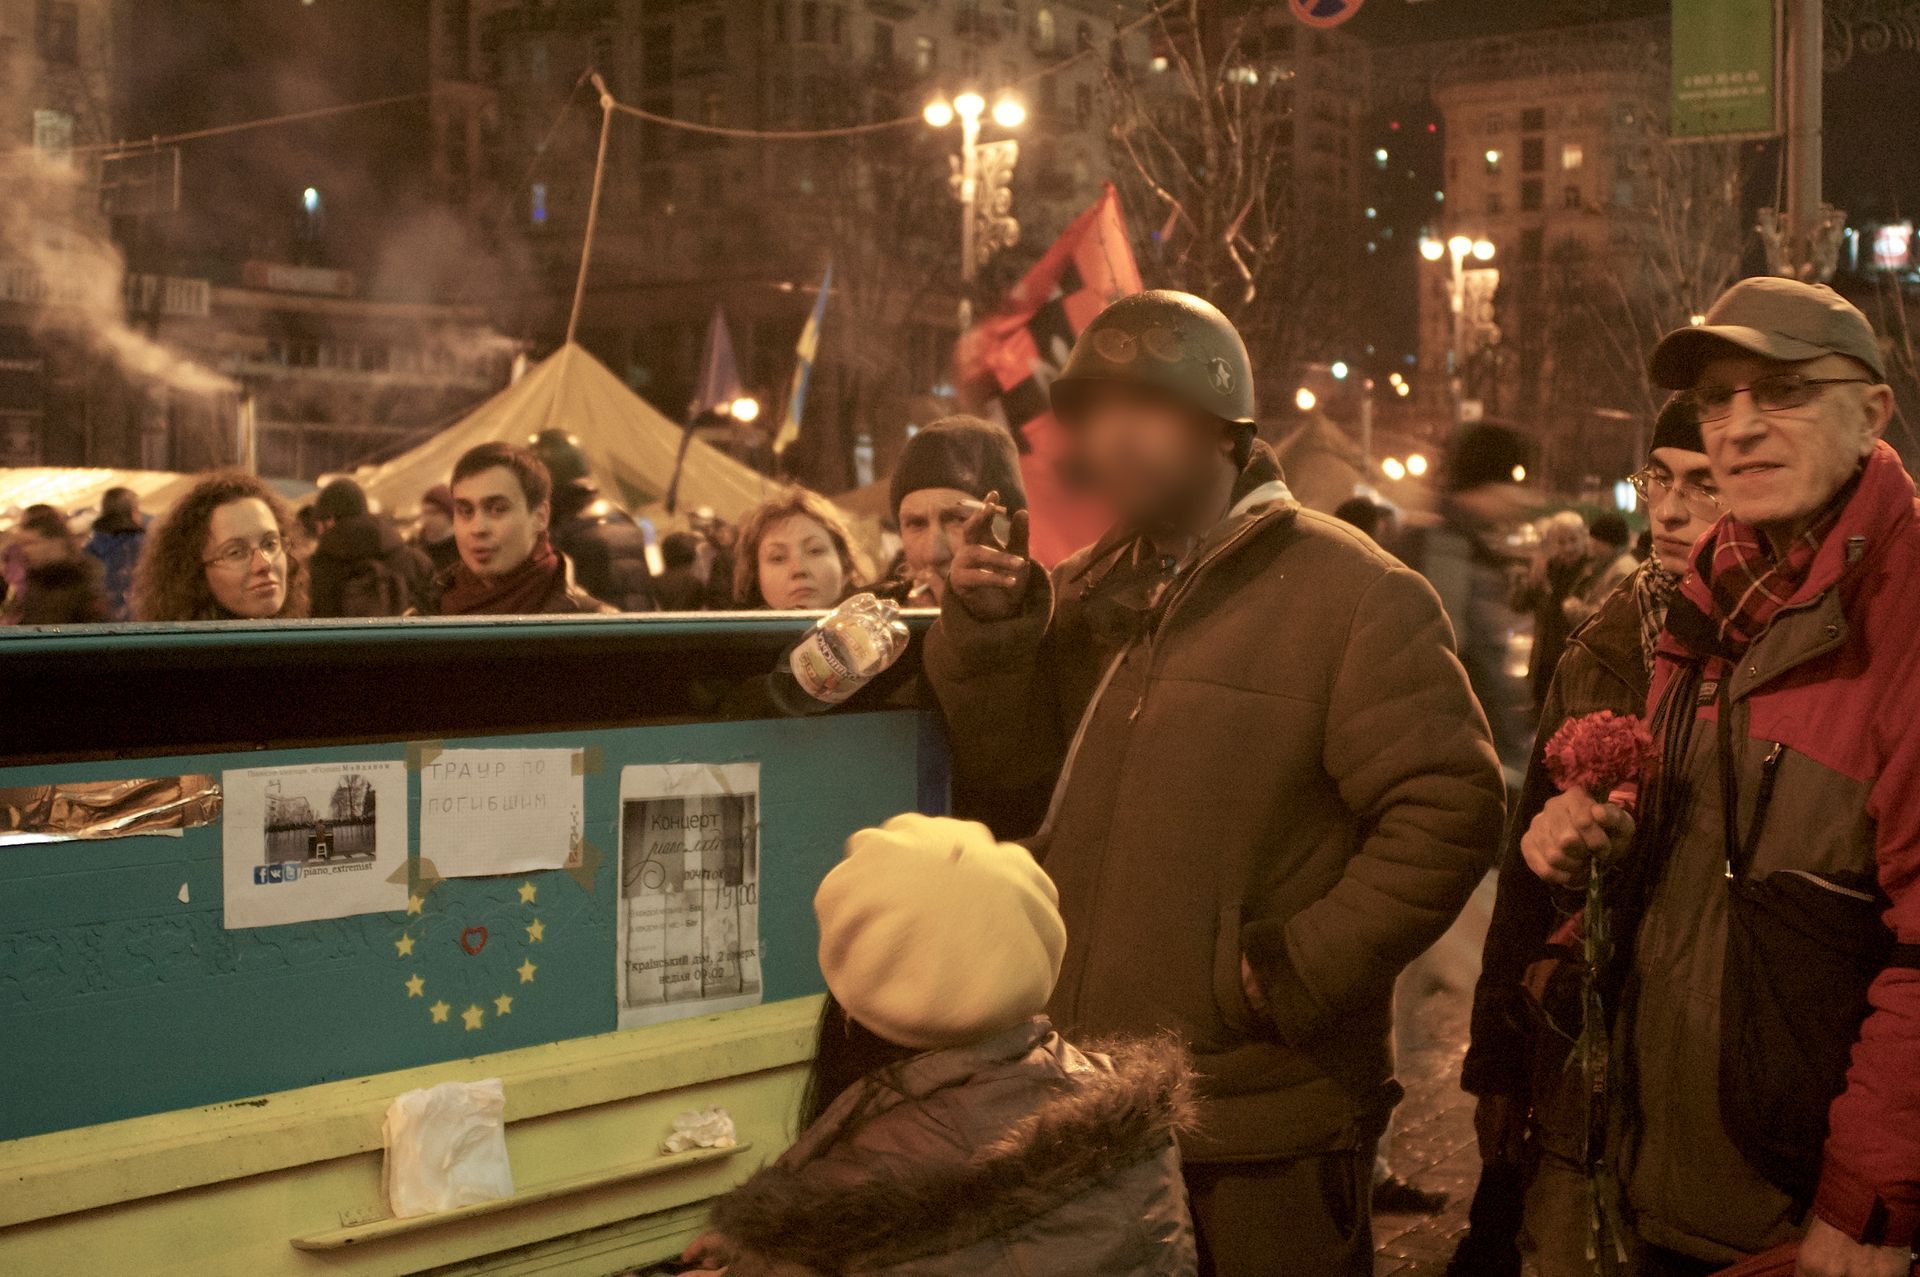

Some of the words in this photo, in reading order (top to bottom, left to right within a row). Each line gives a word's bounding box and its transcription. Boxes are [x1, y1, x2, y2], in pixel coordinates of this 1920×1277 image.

[523, 760, 545, 775] ПО
[428, 793, 547, 813] ПОГИБШИМ
[717, 951, 724, 962] 2
